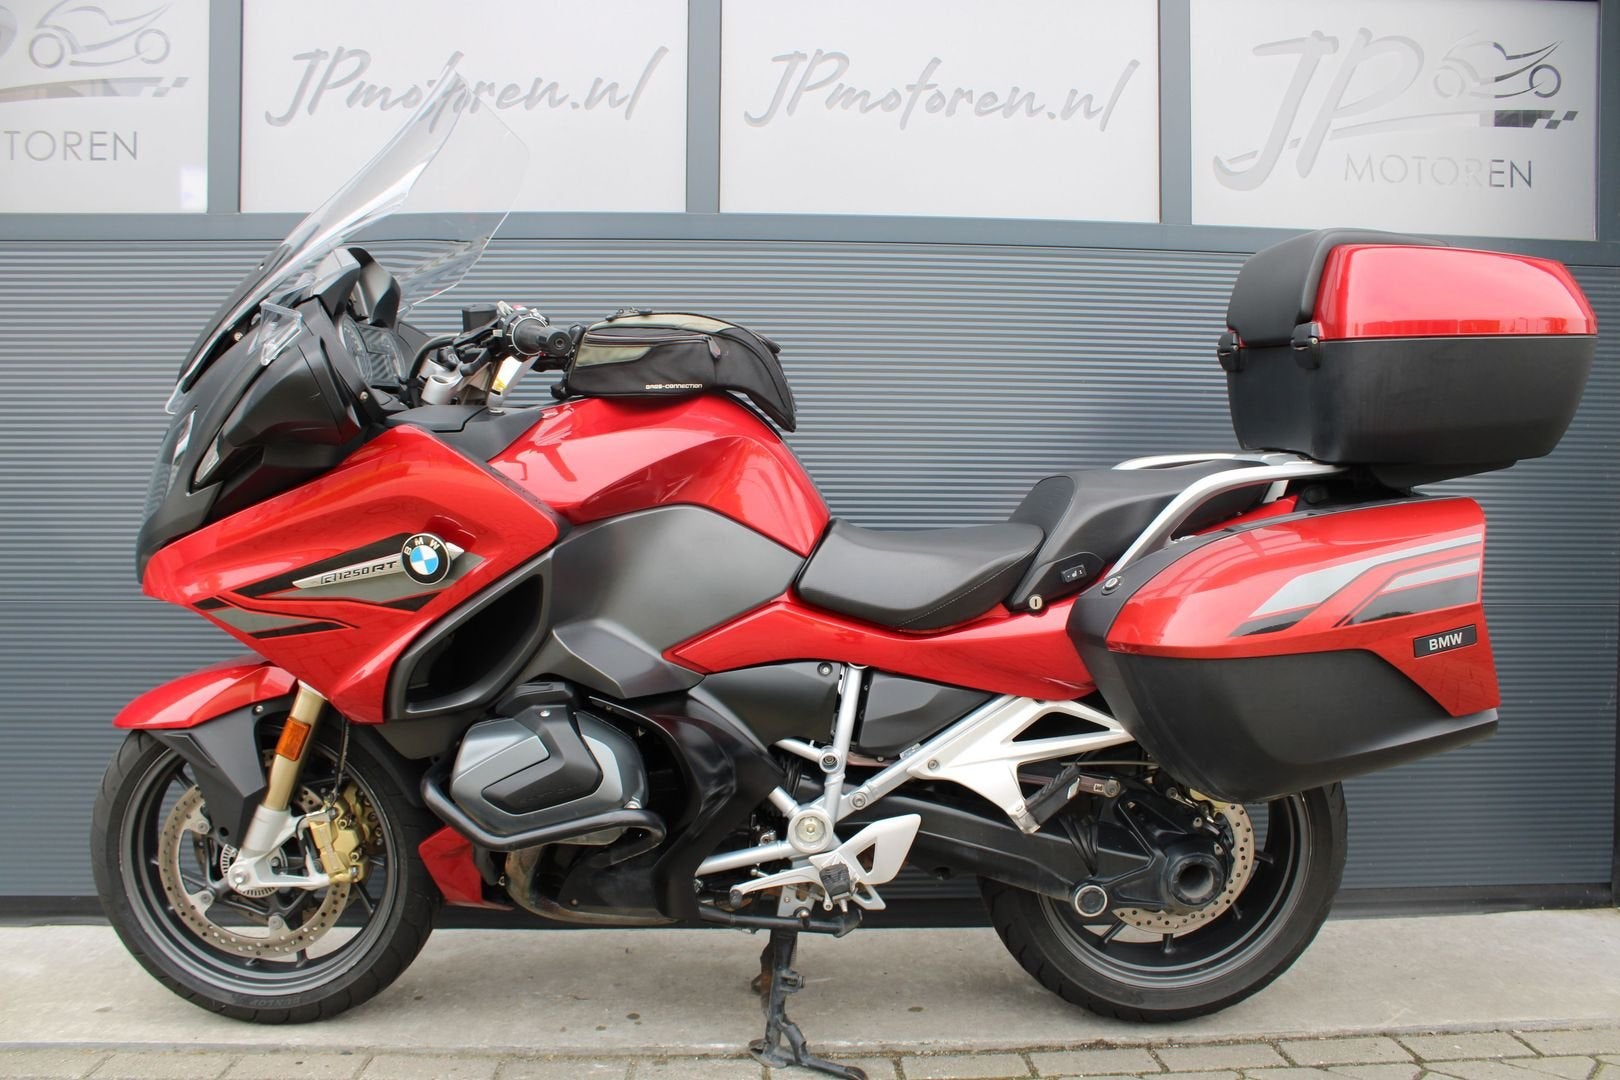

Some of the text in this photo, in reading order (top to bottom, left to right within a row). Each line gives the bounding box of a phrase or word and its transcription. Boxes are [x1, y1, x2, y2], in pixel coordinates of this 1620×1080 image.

[744, 49, 1141, 132] JPmotoren.nl
[1344, 153, 1533, 188] MOTOREN
[403, 536, 441, 556] BMW
[1428, 632, 1463, 651] BMW
